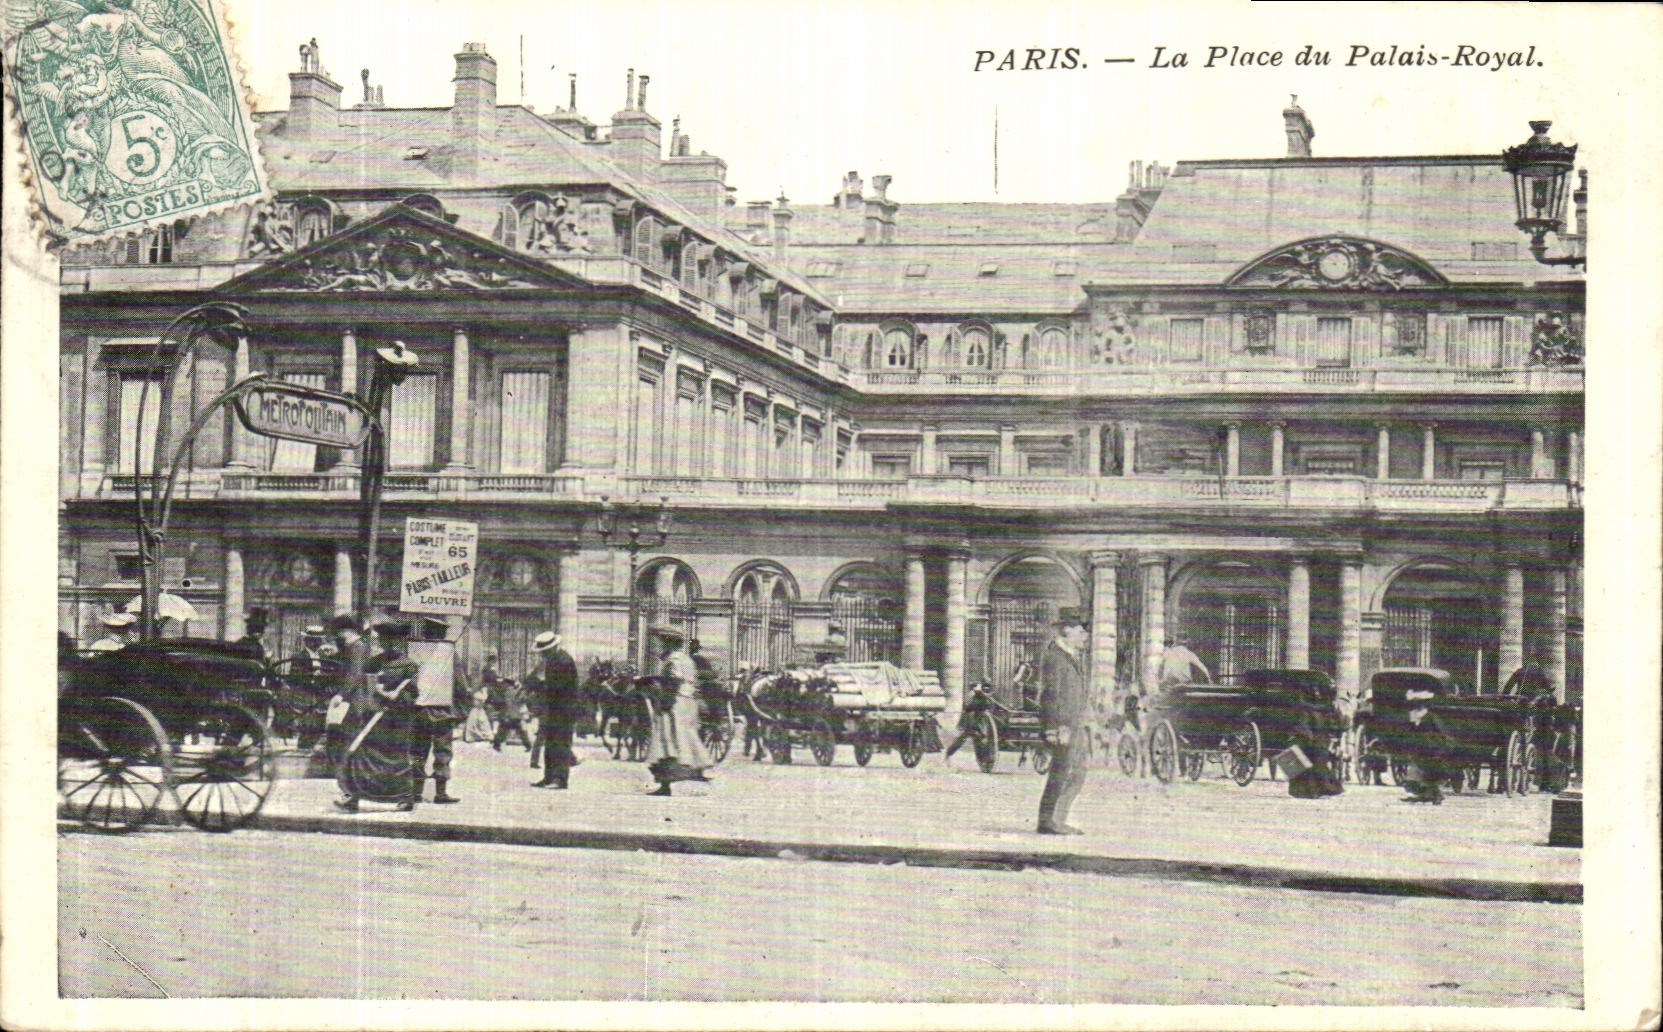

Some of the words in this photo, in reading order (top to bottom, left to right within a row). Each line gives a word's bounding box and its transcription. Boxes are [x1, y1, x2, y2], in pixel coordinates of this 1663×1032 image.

[106, 184, 200, 225] POSTES
[409, 521, 446, 533] COSTUME
[409, 535, 444, 547] COMPLET
[447, 545, 468, 558] 65
[420, 595, 468, 607] LOUVRE
